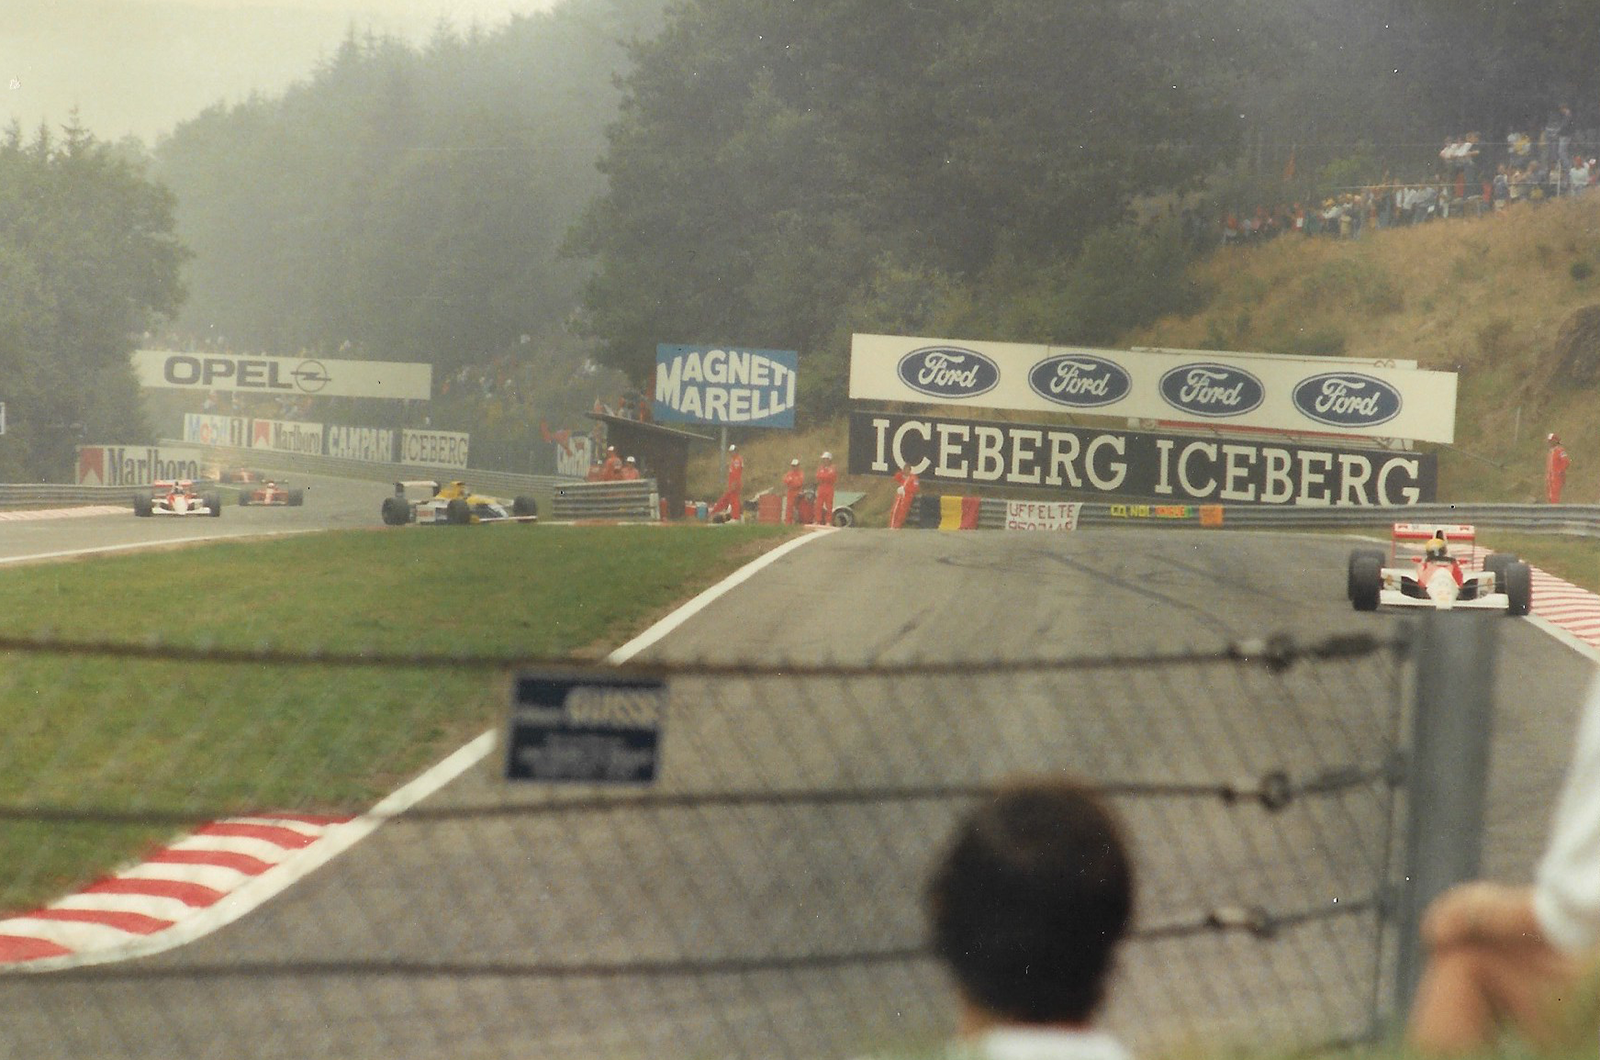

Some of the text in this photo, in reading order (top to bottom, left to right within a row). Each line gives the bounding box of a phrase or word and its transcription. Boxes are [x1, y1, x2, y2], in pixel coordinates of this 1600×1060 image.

[164, 356, 293, 389] OPEL
[656, 350, 796, 409] MAGNETI
[656, 357, 796, 422] MARELLI
[918, 352, 1381, 417] Ford Ford Ford Ford
[272, 422, 321, 454] Marlboro
[328, 425, 393, 462] CAMPARI
[402, 433, 468, 465] ICEBERG
[108, 448, 198, 486] Marlboro
[871, 418, 1421, 508] ICEBERG ICEBERG
